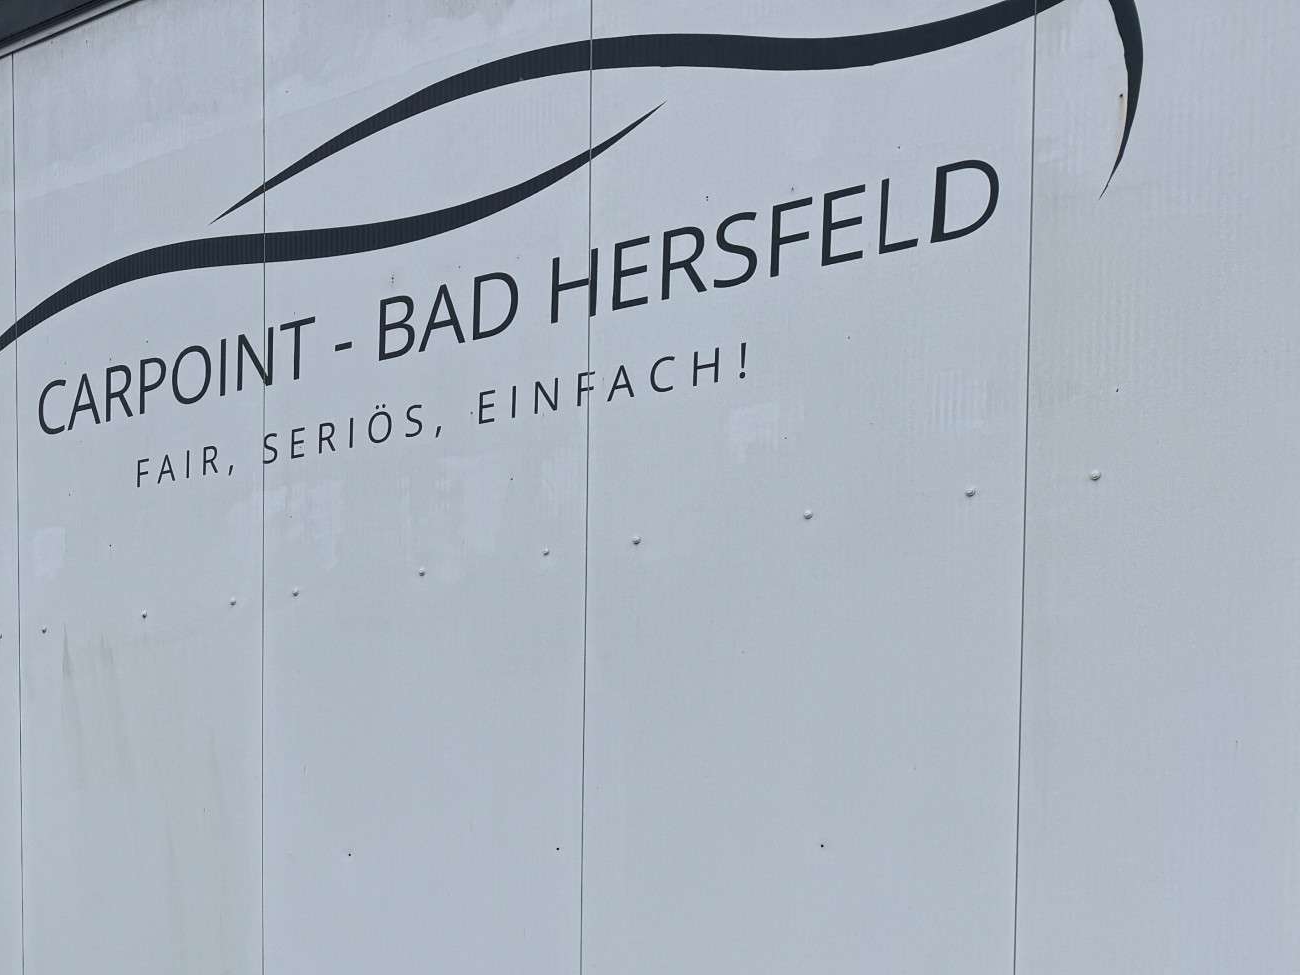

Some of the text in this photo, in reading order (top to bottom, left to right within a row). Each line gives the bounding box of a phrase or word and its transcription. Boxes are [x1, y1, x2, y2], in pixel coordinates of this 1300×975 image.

[38, 159, 1000, 435] CARPOINT - BAD HERSFELD
[136, 342, 747, 488] FAIR, SERIÖS, EINFACH!
